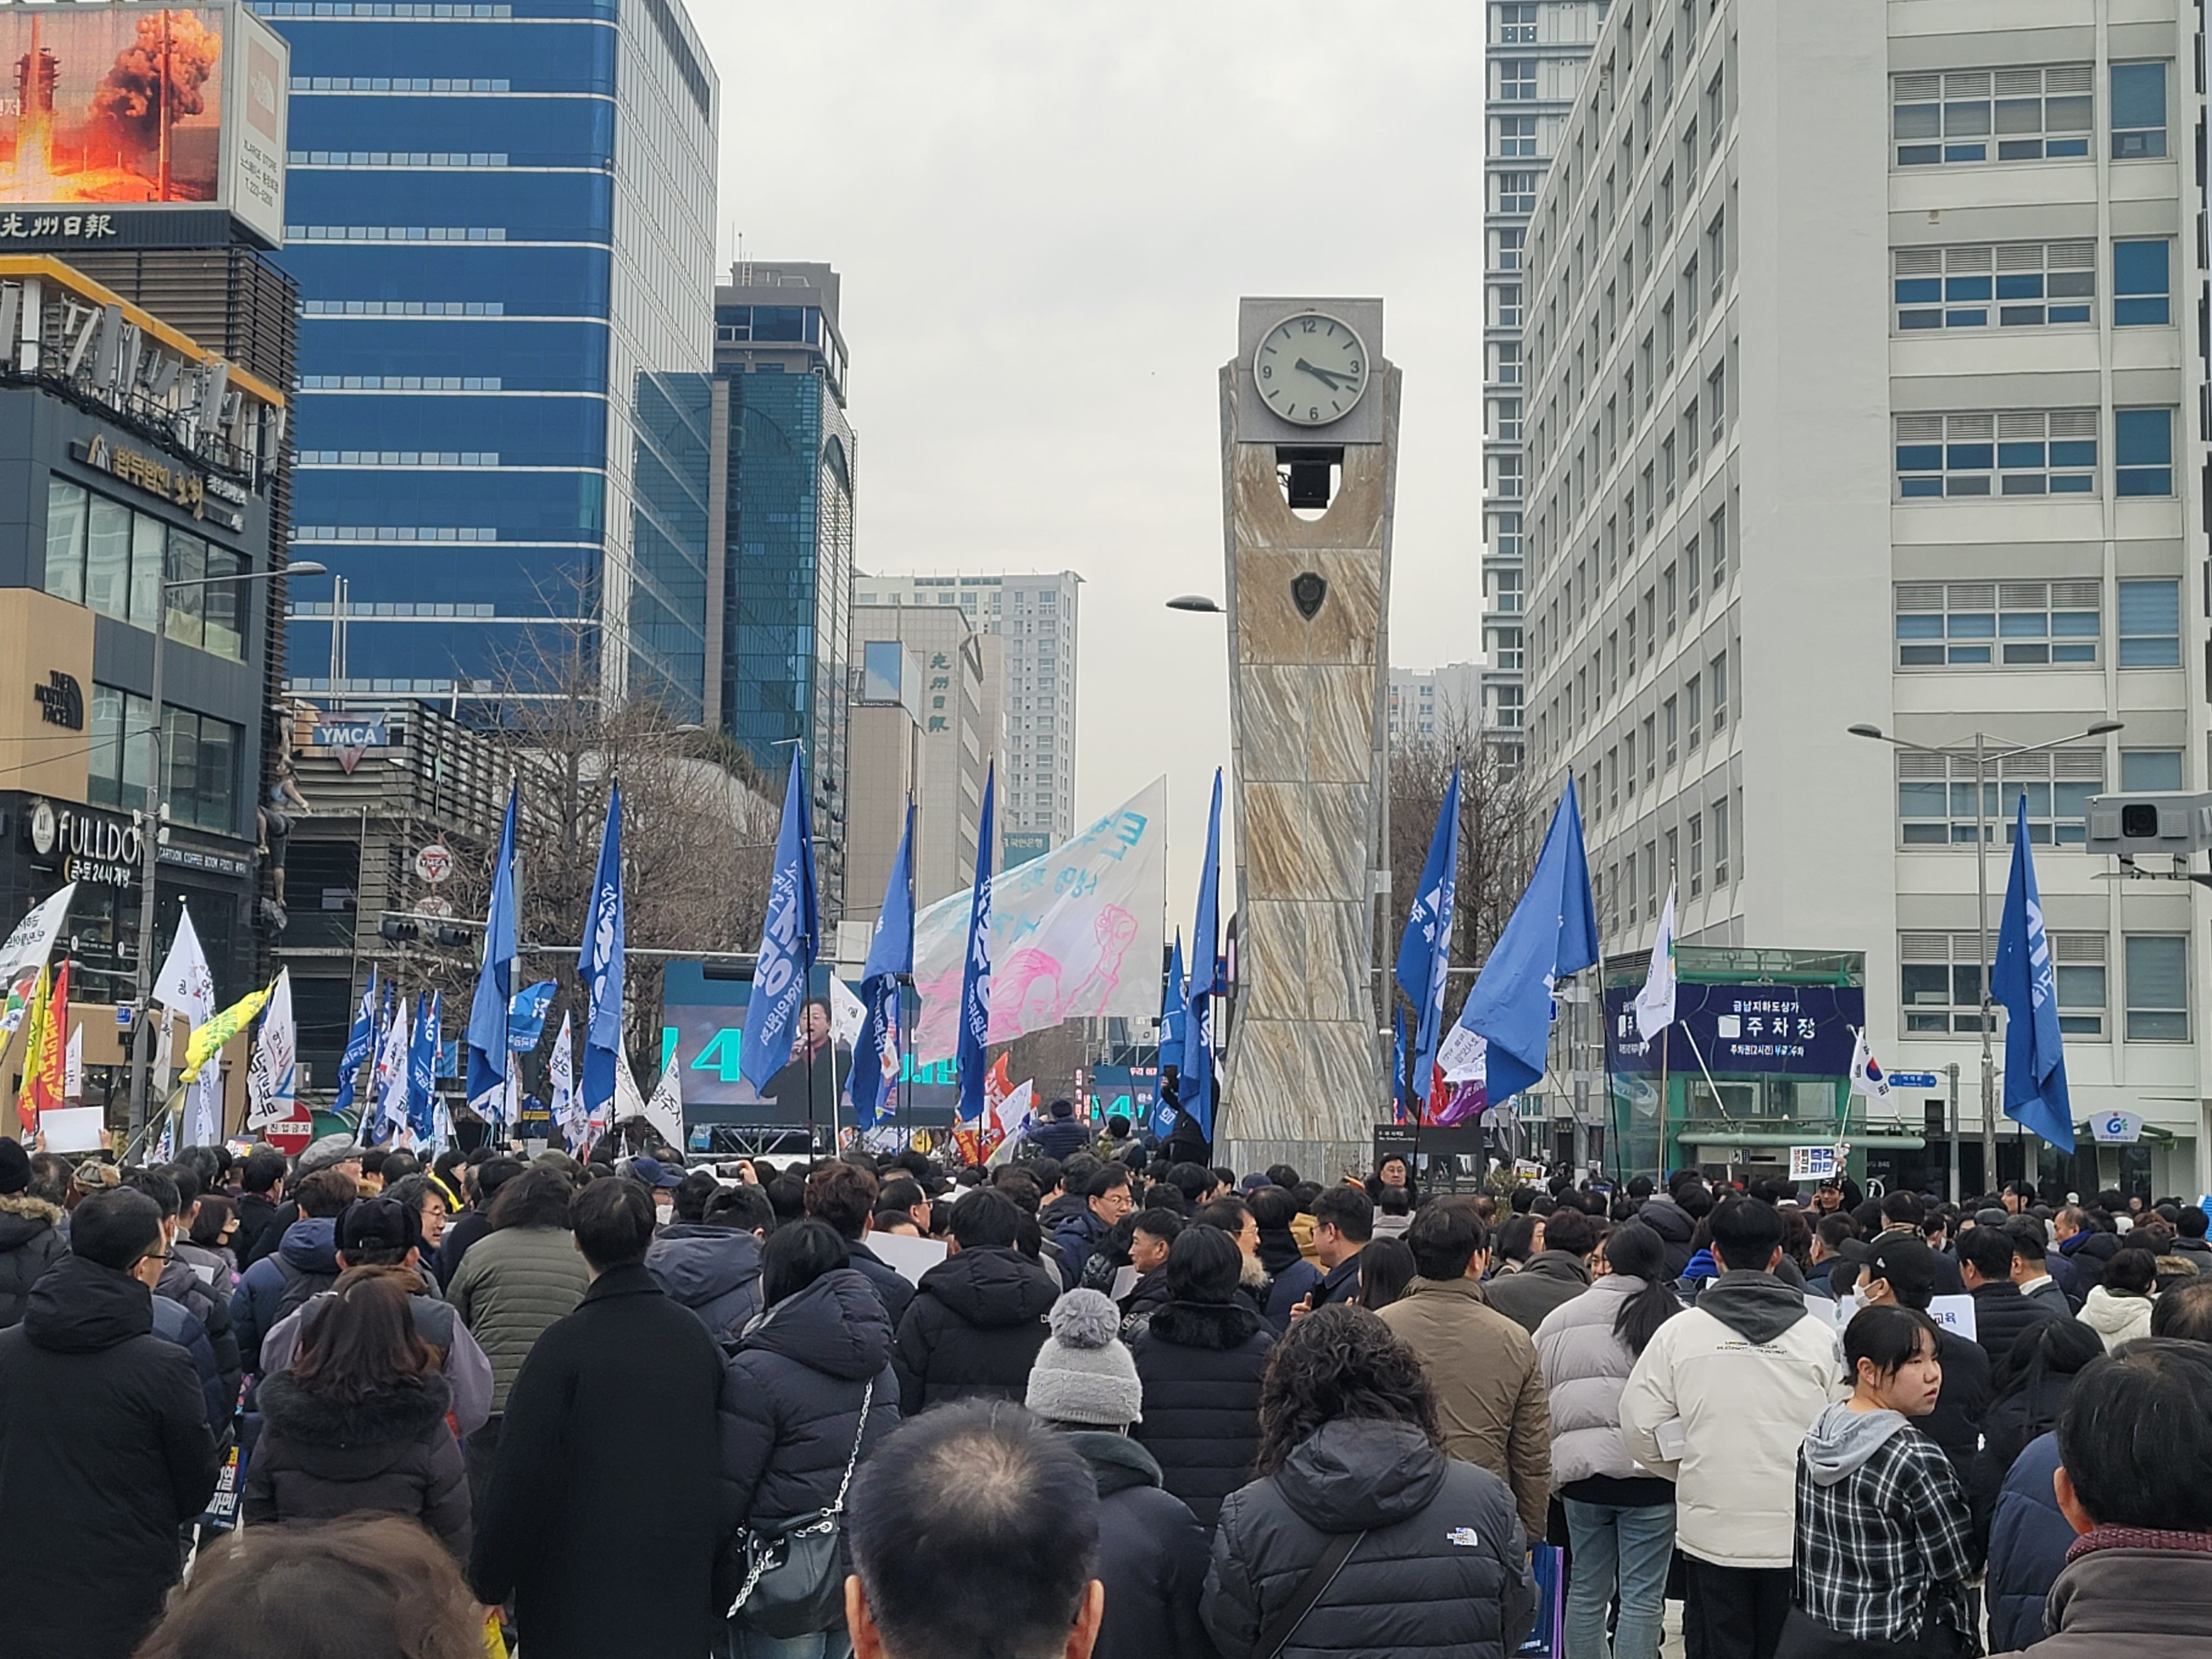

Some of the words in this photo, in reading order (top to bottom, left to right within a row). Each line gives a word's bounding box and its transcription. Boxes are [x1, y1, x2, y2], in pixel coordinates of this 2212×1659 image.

[1300, 319, 1316, 333] 12
[1262, 365, 1272, 379] 9
[1350, 360, 1359, 374] 3
[1309, 407, 1319, 420] 6
[321, 728, 377, 743] YMCA
[420, 859, 452, 868] YMCA
[1733, 1000, 1799, 1014] 금남지하도상가
[270, 1123, 309, 1133] 진입금지
